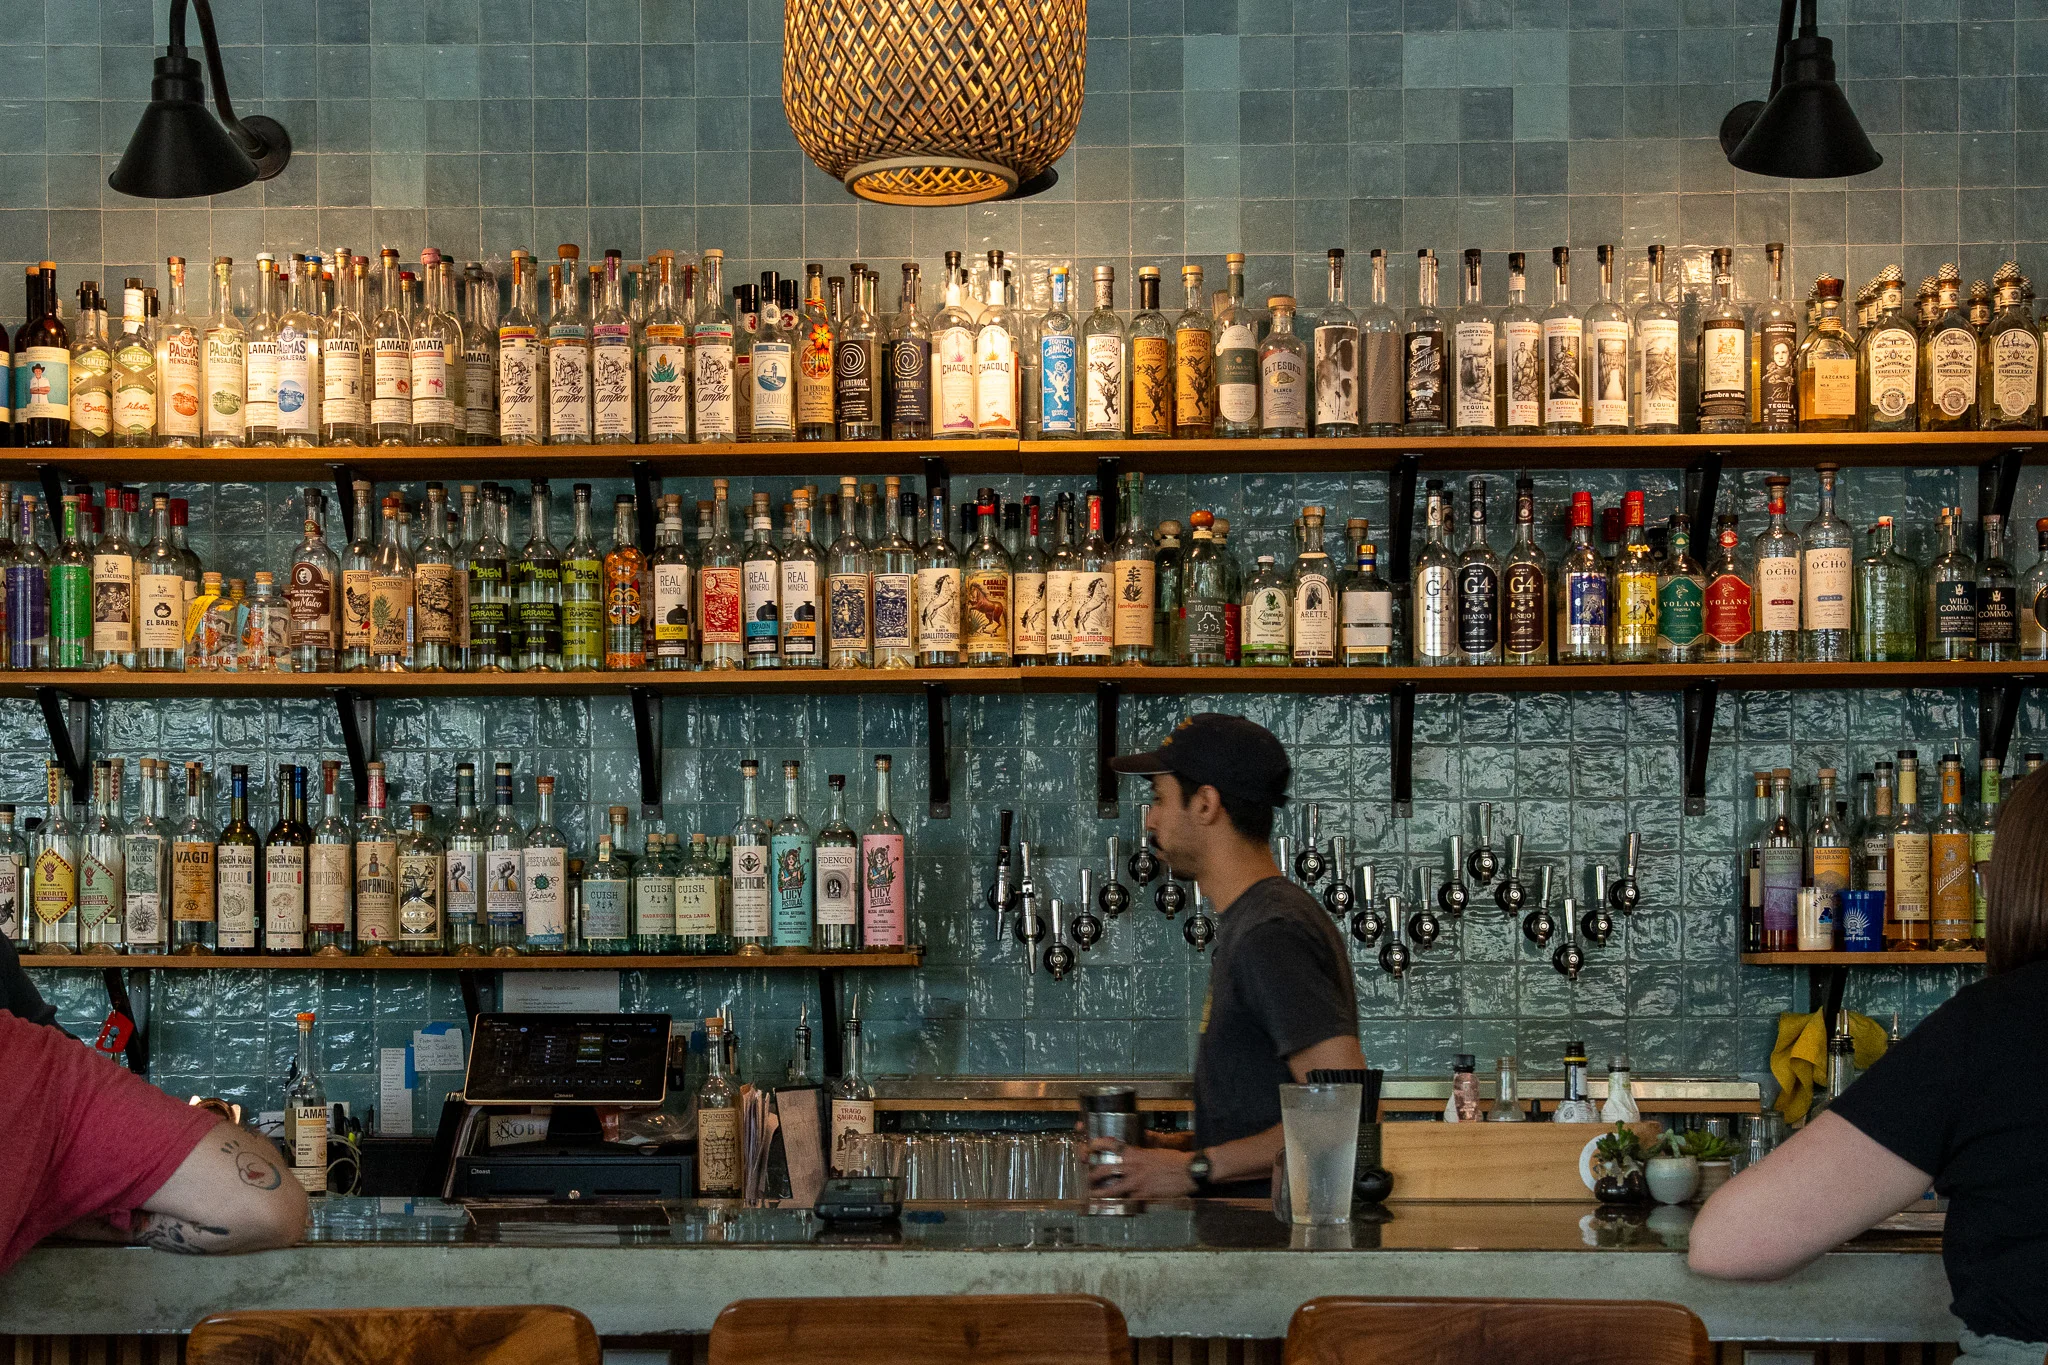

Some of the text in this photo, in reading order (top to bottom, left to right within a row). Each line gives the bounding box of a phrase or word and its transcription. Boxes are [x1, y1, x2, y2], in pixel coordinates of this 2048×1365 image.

[210, 342, 242, 358] PALOMAS
[249, 344, 276, 355] LAMAT
[326, 341, 359, 351] LAMATA
[376, 340, 409, 351] LAMATA
[413, 340, 444, 351] LAMATA
[465, 352, 491, 363] AMATA
[979, 363, 1009, 374] CHACOLO
[1272, 361, 1301, 376] TESORO
[1812, 561, 1847, 569] OCHO
[749, 571, 769, 583] REAL
[787, 571, 808, 583] REAL
[1766, 568, 1797, 576] OCHO
[660, 575, 681, 587] REAL
[1463, 576, 1491, 594] G4
[1510, 576, 1537, 594] G4
[660, 587, 681, 595] MINERO
[749, 583, 770, 592] MINERO
[787, 584, 809, 592] MINERO
[1425, 579, 1451, 597] G4
[1300, 610, 1328, 619] ARETTE
[156, 619, 178, 627] BARRO
[1197, 623, 1221, 634] 1905
[131, 855, 153, 863] ANDES
[176, 851, 209, 864] VAGO
[818, 856, 852, 866] FIDENCIO
[643, 884, 672, 894] CUISH
[678, 884, 705, 894] CUISH
[782, 889, 802, 900] LUCY
[870, 887, 891, 898] LUCY
[590, 891, 618, 900] CUISH
[841, 1107, 862, 1115] TRAGO
[836, 1113, 867, 1123] SAGRADO
[499, 1122, 546, 1136] NOBL
